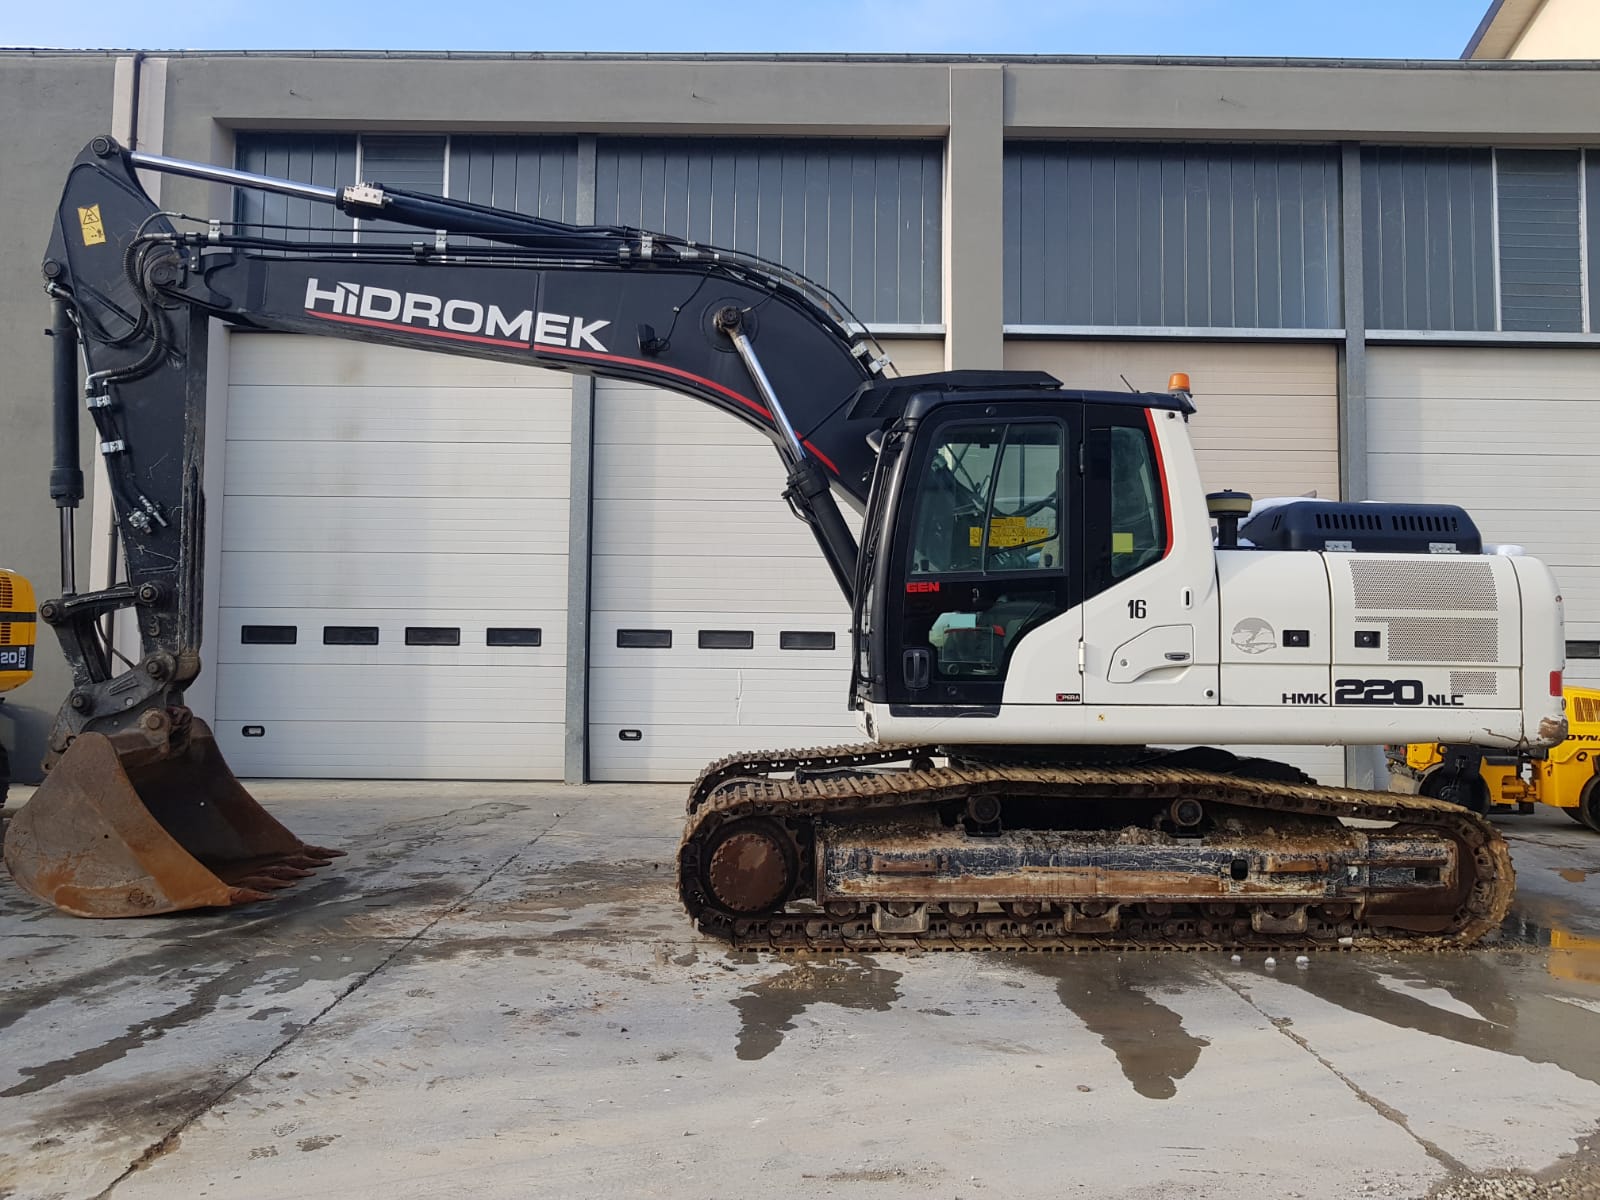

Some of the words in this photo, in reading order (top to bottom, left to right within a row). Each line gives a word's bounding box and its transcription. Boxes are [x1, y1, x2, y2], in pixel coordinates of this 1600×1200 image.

[906, 581, 940, 593] GEN
[1128, 599, 1147, 619] 16
[0, 651, 18, 664] 20
[1056, 693, 1081, 702] OPERA
[1282, 693, 1328, 705] HMK
[1335, 679, 1424, 705] 220
[1427, 694, 1465, 706] NLC
